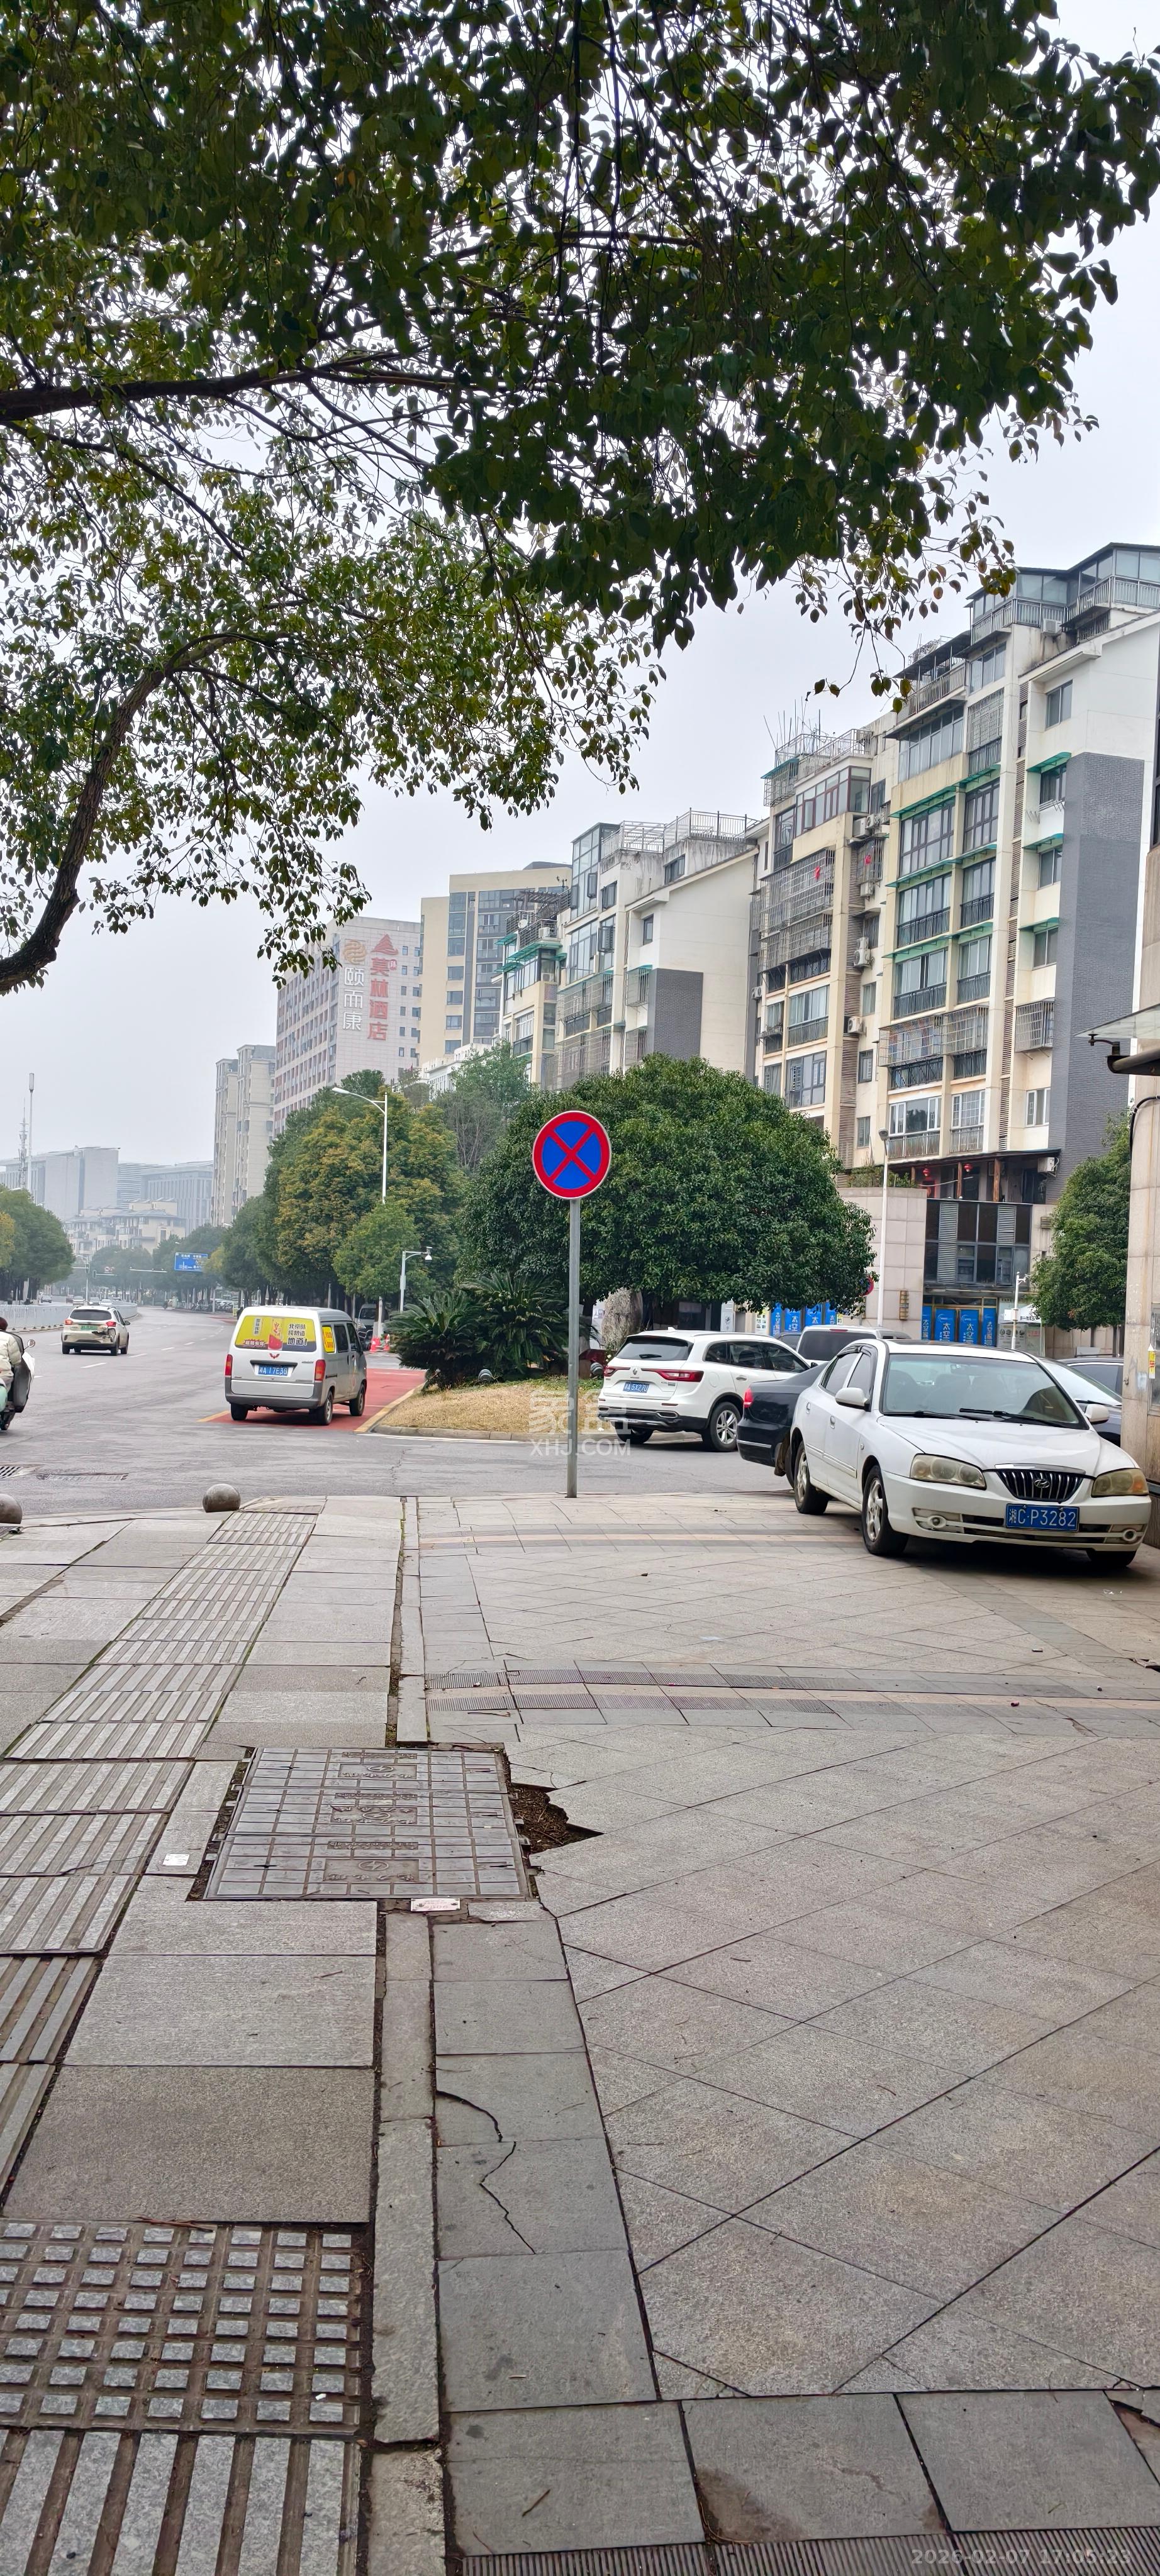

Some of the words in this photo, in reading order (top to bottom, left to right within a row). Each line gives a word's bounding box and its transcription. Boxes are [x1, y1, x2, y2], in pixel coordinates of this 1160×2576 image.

[343, 967, 364, 1031] 颐而康
[367, 957, 389, 1041] 莫林酒店
